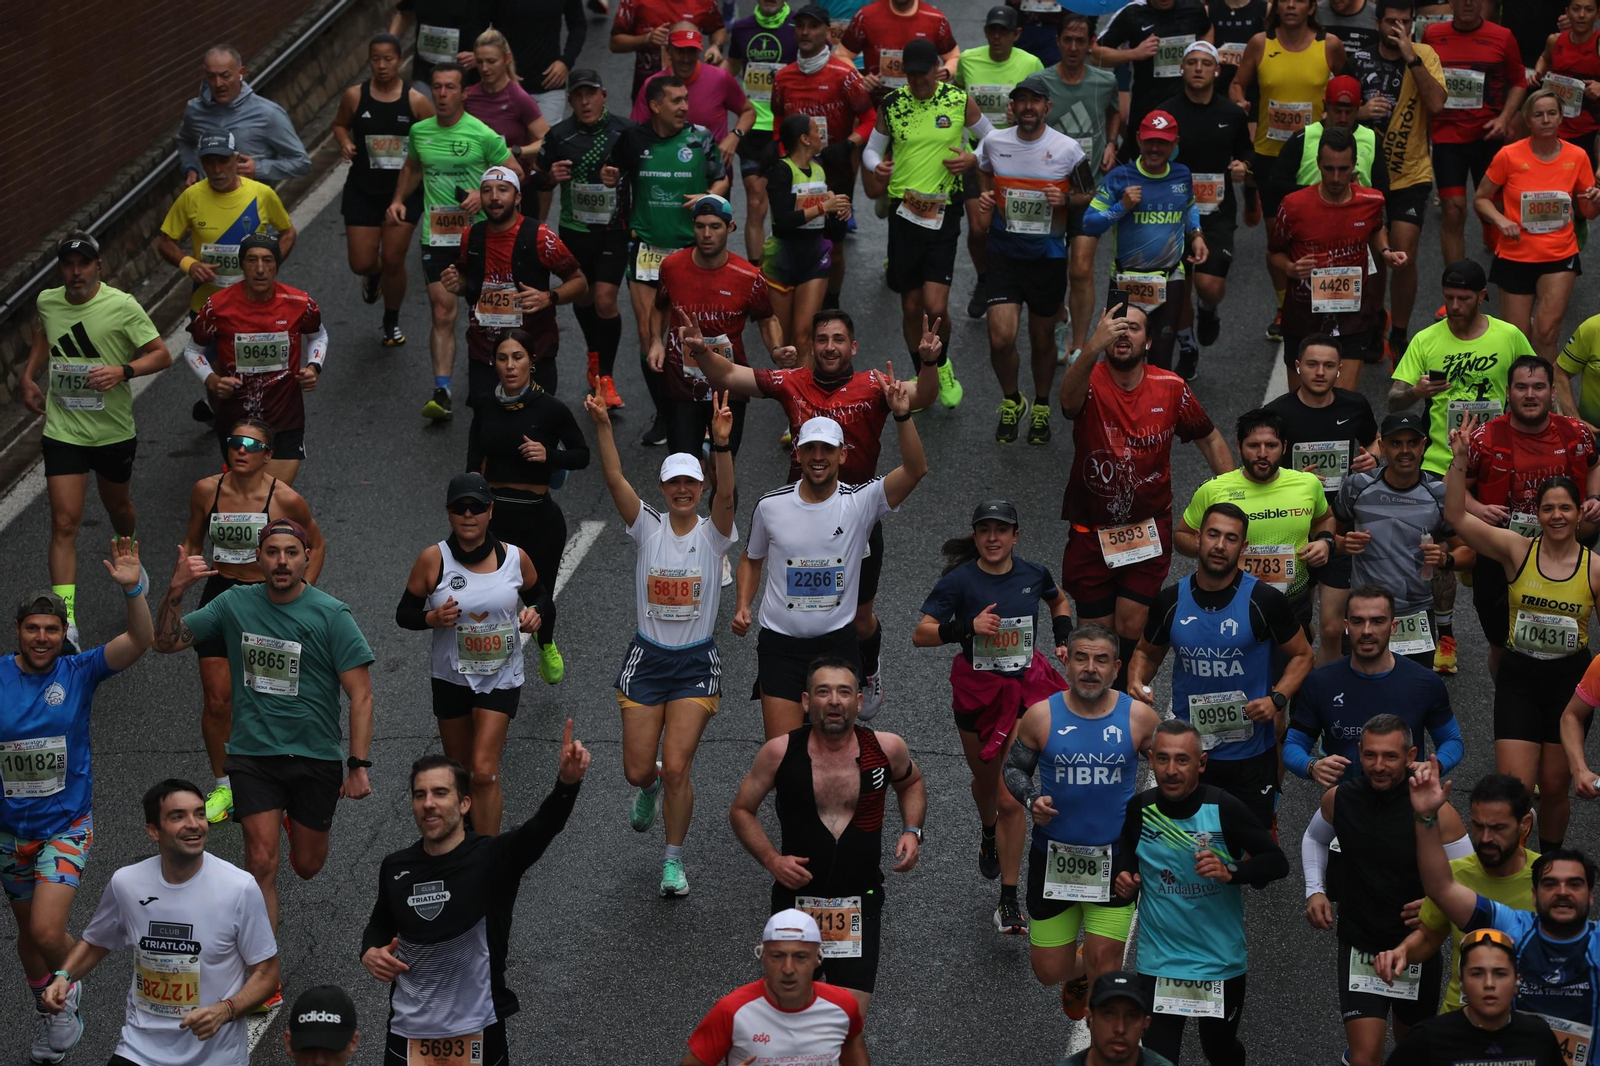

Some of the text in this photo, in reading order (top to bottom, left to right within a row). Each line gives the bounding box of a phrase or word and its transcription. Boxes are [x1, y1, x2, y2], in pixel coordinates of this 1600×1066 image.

[423, 35, 449, 50] 8595
[1160, 45, 1186, 60] 1028
[748, 72, 773, 85] 1516
[1446, 80, 1473, 92] 6954
[974, 93, 1002, 108] 8261
[1274, 112, 1301, 124] 5230
[1390, 98, 1417, 174] MARATÓN
[372, 139, 400, 151] 8273
[577, 194, 606, 206] 6699
[1012, 200, 1042, 215] 9872
[1528, 201, 1560, 215] 8035
[436, 215, 465, 227] 4040
[1133, 211, 1183, 224] TUSSAM
[1319, 279, 1351, 292] 4426
[480, 293, 511, 307] 4425
[243, 345, 277, 359] 9643
[1301, 453, 1338, 469] 9220
[1089, 457, 1115, 485] 30
[217, 526, 252, 541] 9290
[1108, 526, 1144, 546] 5893
[1244, 558, 1282, 574] 5783
[794, 571, 832, 588] 2266
[654, 580, 690, 597] 5818
[1521, 594, 1583, 614] TRIBOOST
[984, 630, 1020, 649] 7400
[1520, 625, 1567, 646] 10431
[464, 634, 503, 653] 9089
[248, 649, 286, 670] 8865
[1178, 646, 1245, 659] AVANZA
[1181, 658, 1246, 679] FIBRA
[1198, 705, 1237, 726] 9996
[1343, 726, 1366, 738] SER
[4, 752, 57, 772] 10182
[1052, 752, 1127, 765] AVANZA
[1055, 767, 1123, 786] FIBRA
[1056, 856, 1098, 877] 9998
[1157, 882, 1221, 897] AndalBrok
[411, 893, 447, 905] TRIATLÓN
[811, 911, 846, 931] 113
[159, 927, 181, 938] CLUB
[144, 939, 196, 953] TRIATLÓN
[143, 978, 194, 1002] 12728
[1519, 987, 1584, 997] COSTA TROPICAL
[297, 1010, 342, 1024] adidas
[752, 1033, 771, 1045] edp
[419, 1039, 465, 1057] 5693
